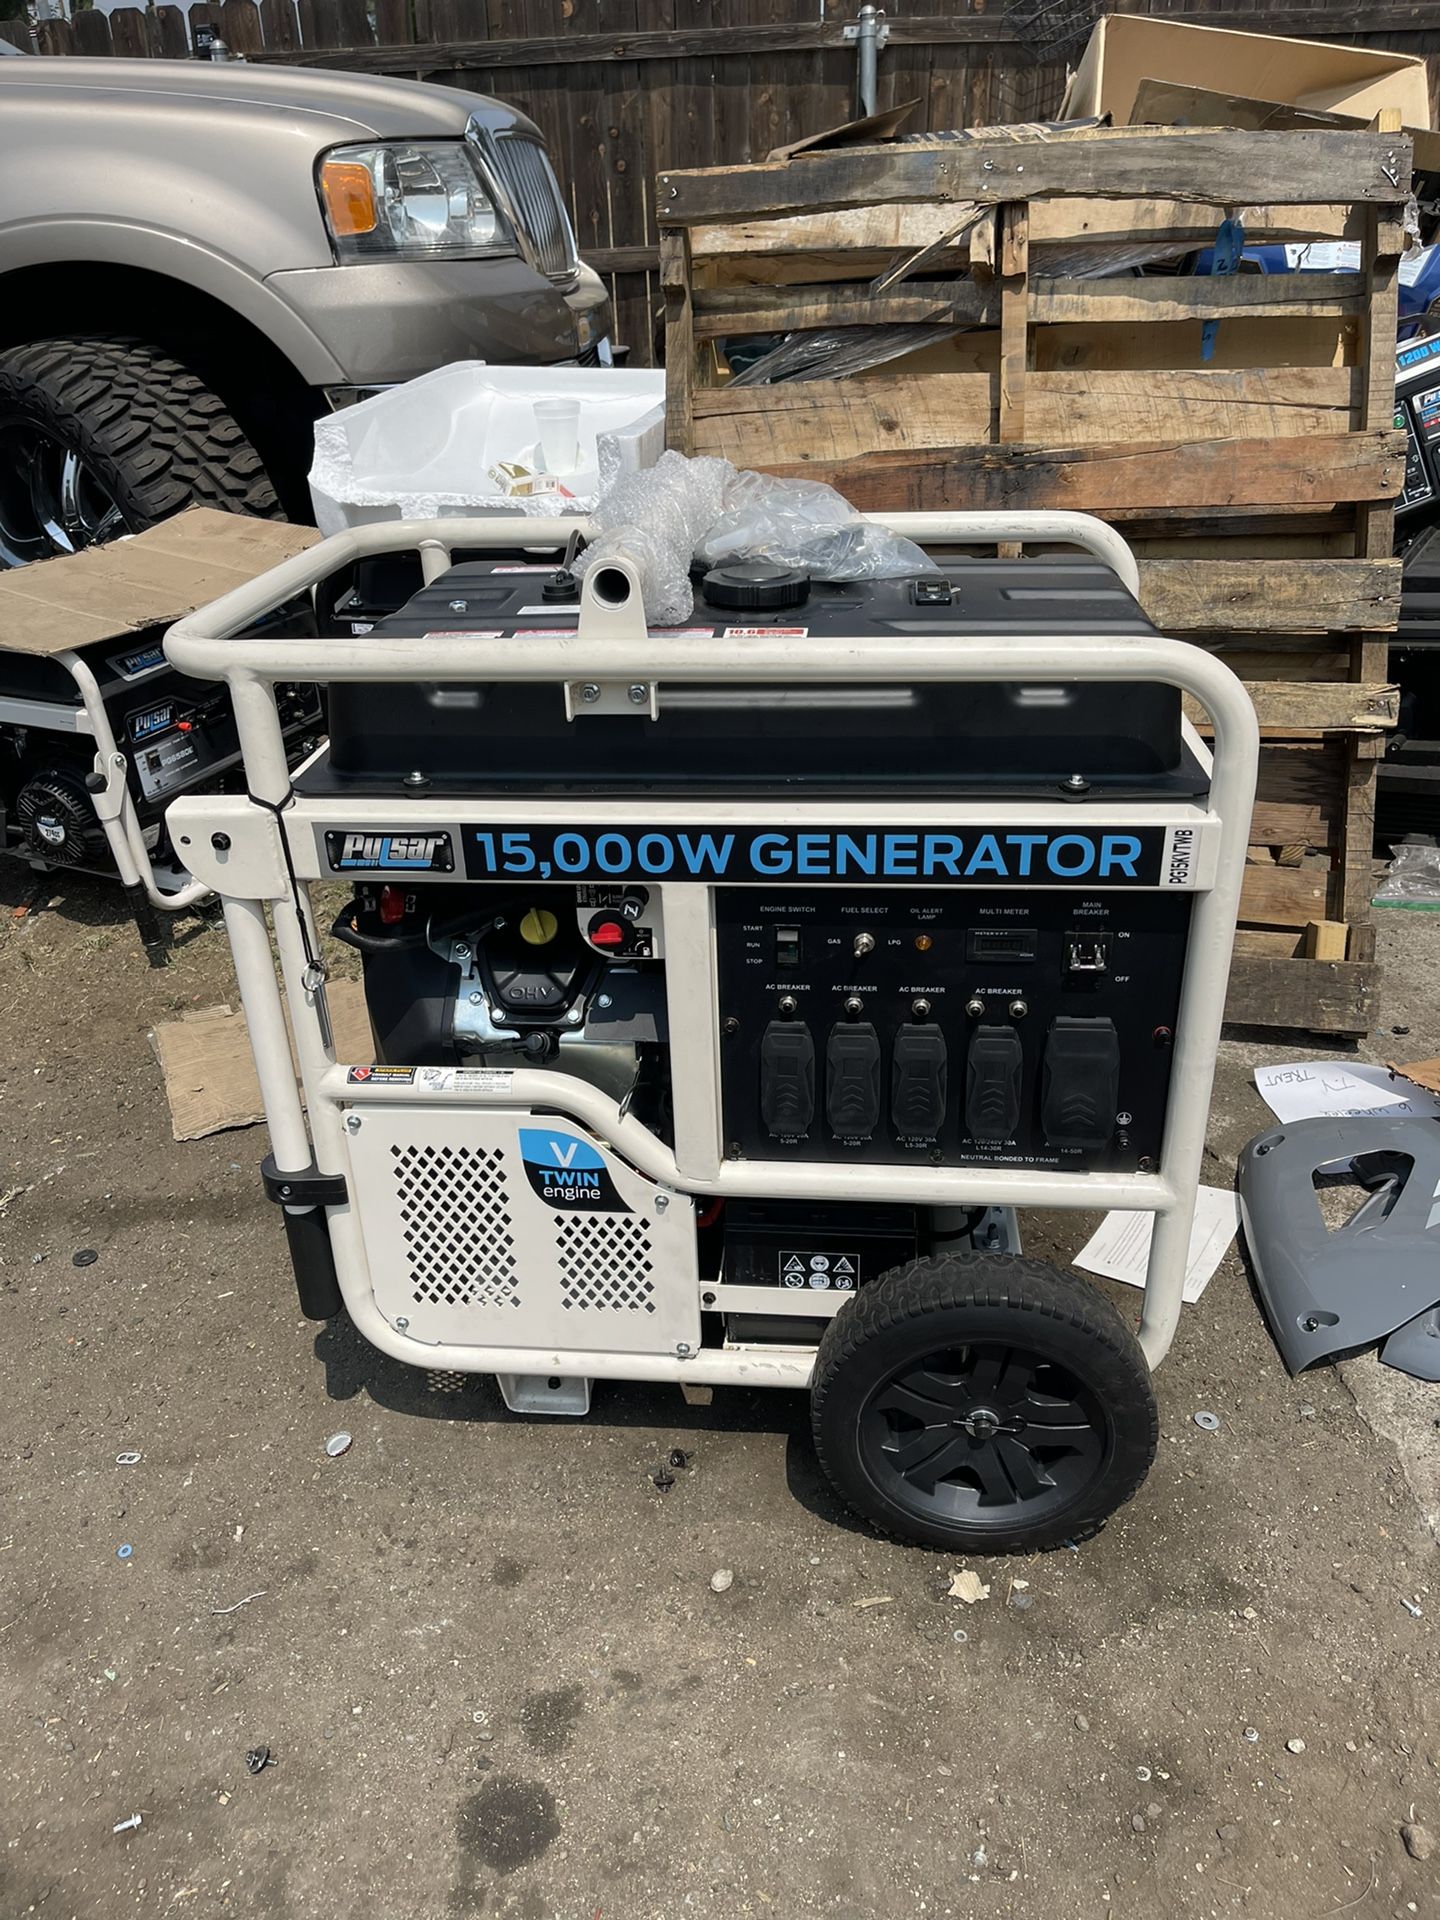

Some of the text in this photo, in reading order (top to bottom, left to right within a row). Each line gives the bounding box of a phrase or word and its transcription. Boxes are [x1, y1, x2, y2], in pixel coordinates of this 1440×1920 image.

[1399, 347, 1429, 366] 1200
[341, 832, 1142, 879] Pulsar 15,000W GENERATOR
[1169, 829, 1193, 884] PG15KVTWB
[509, 986, 555, 999] OHV
[1265, 1069, 1316, 1087] TRENT
[549, 1141, 578, 1168] V
[539, 1170, 600, 1187] TWIN
[543, 1186, 601, 1200] engine
